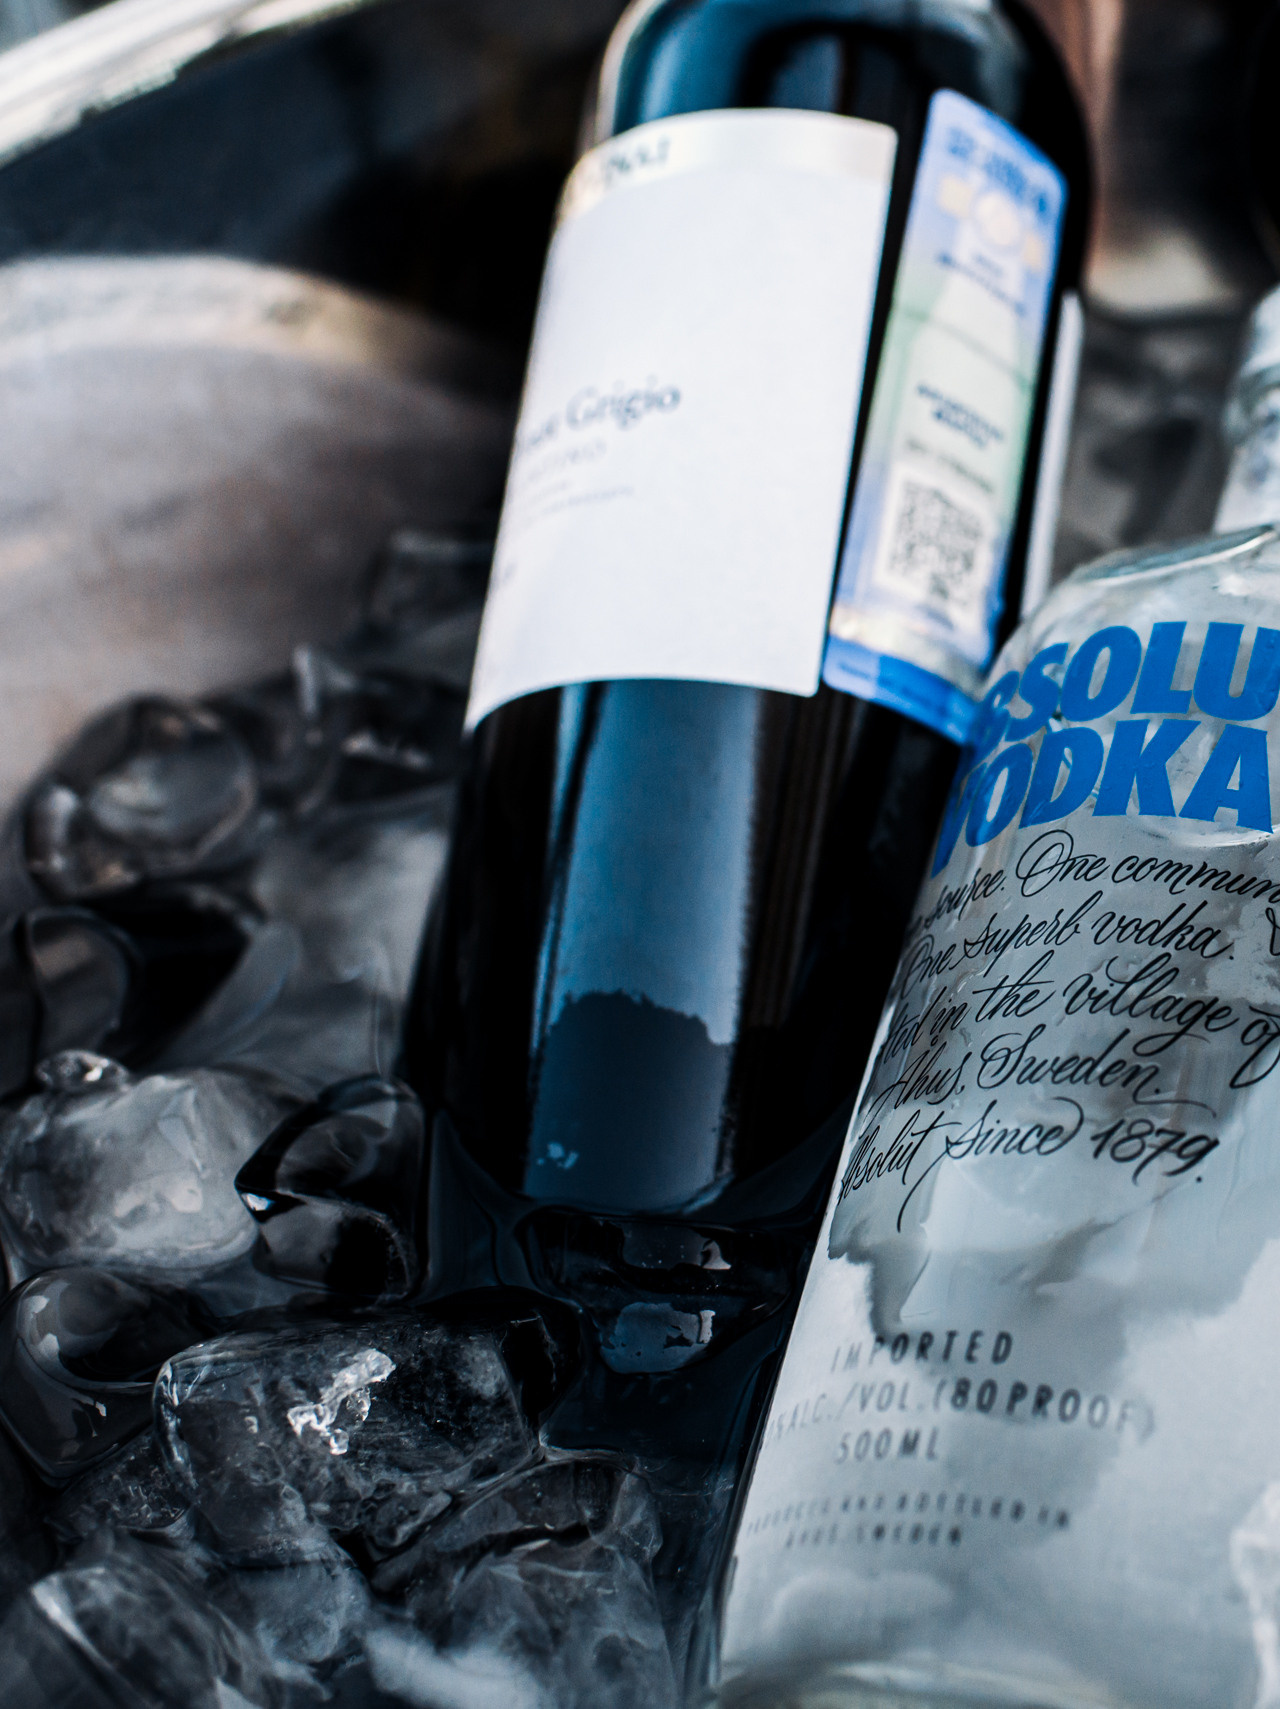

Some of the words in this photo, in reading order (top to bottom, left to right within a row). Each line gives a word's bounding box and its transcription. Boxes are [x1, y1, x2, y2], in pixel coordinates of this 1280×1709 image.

[931, 718, 1274, 879] VODKA
[1015, 829, 1110, 897] One
[963, 890, 1106, 978] superb
[1091, 900, 1235, 960] vodka.
[929, 997, 974, 1034] in
[972, 950, 1056, 1022] the
[1062, 952, 1240, 1057] village
[977, 1023, 1217, 1118] Sweden.
[1090, 1119, 1220, 1184] 1879.
[831, 1329, 1013, 1374] IMPORTED
[834, 1426, 941, 1465] 500ML
